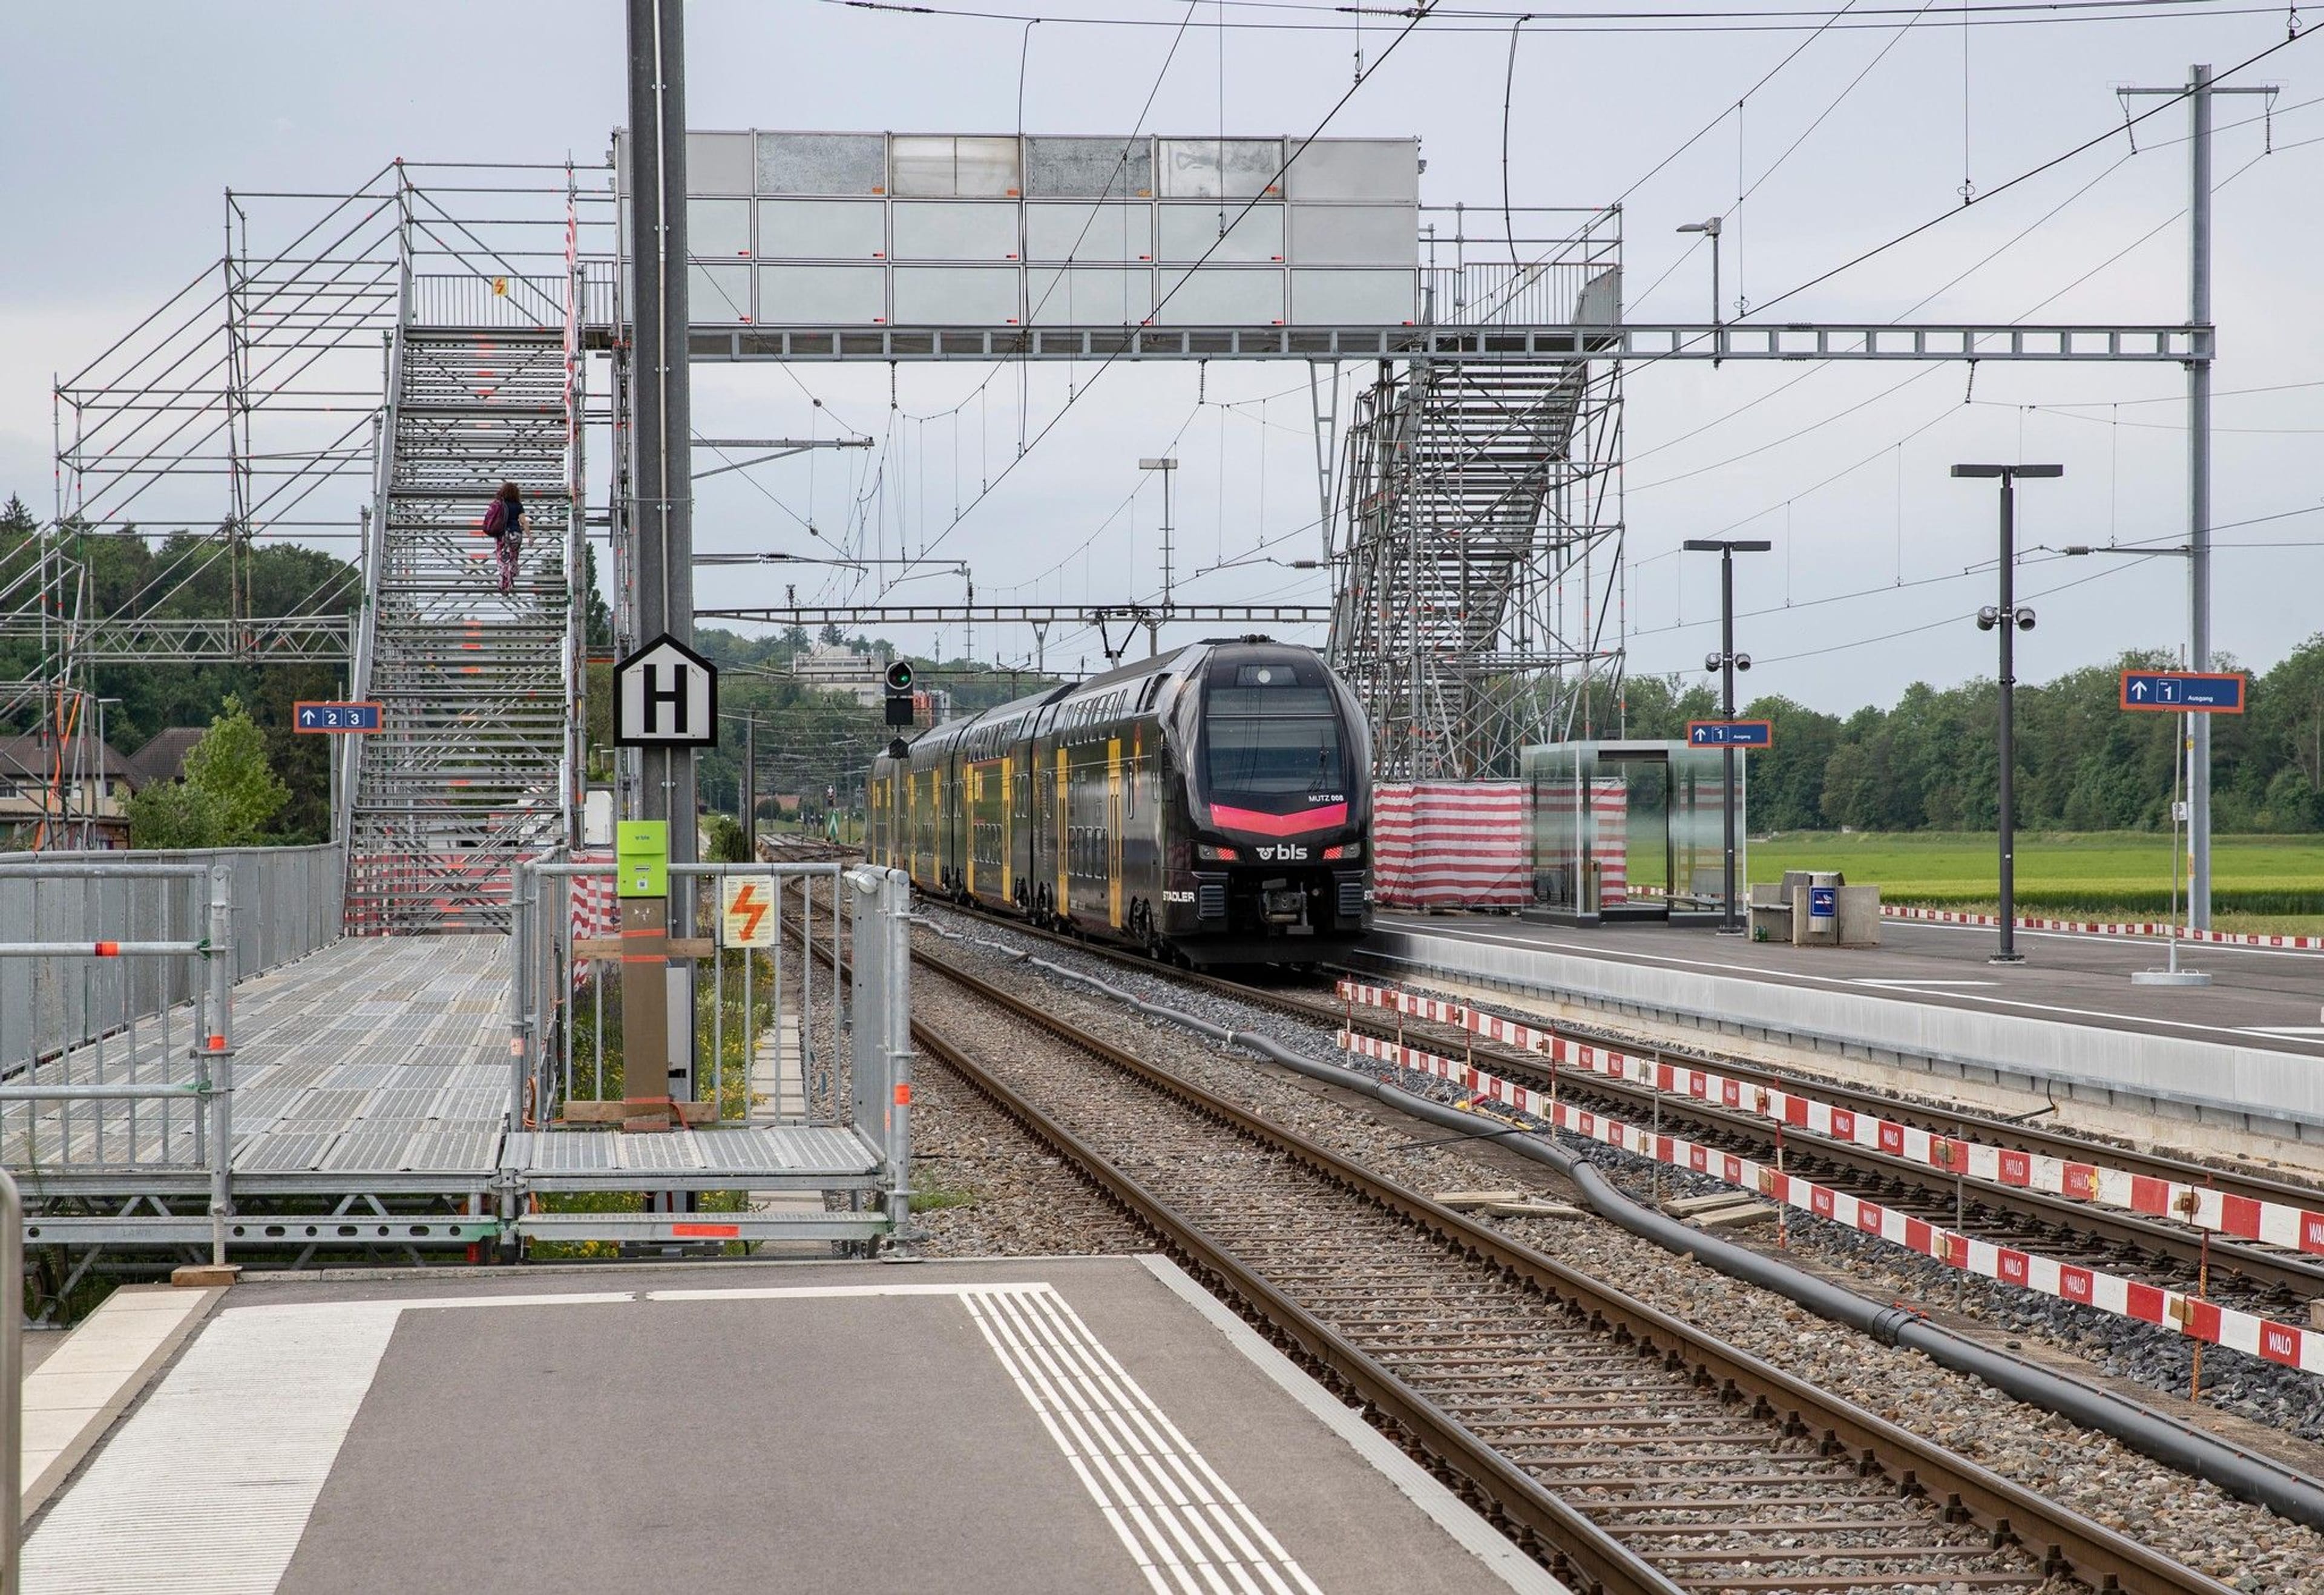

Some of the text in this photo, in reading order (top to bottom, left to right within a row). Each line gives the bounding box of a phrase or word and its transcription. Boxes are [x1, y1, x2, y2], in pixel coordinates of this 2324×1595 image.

[643, 664, 688, 733] H
[2164, 686, 2172, 700] 1
[328, 713, 359, 725] 2 3
[1717, 729, 1723, 739] 1
[1277, 843, 1308, 860] bls
[1163, 890, 1195, 902] STADLER
[2004, 1257, 2023, 1277] WALO
[2066, 1274, 2086, 1295] WALO
[2269, 1331, 2292, 1356] WALO
